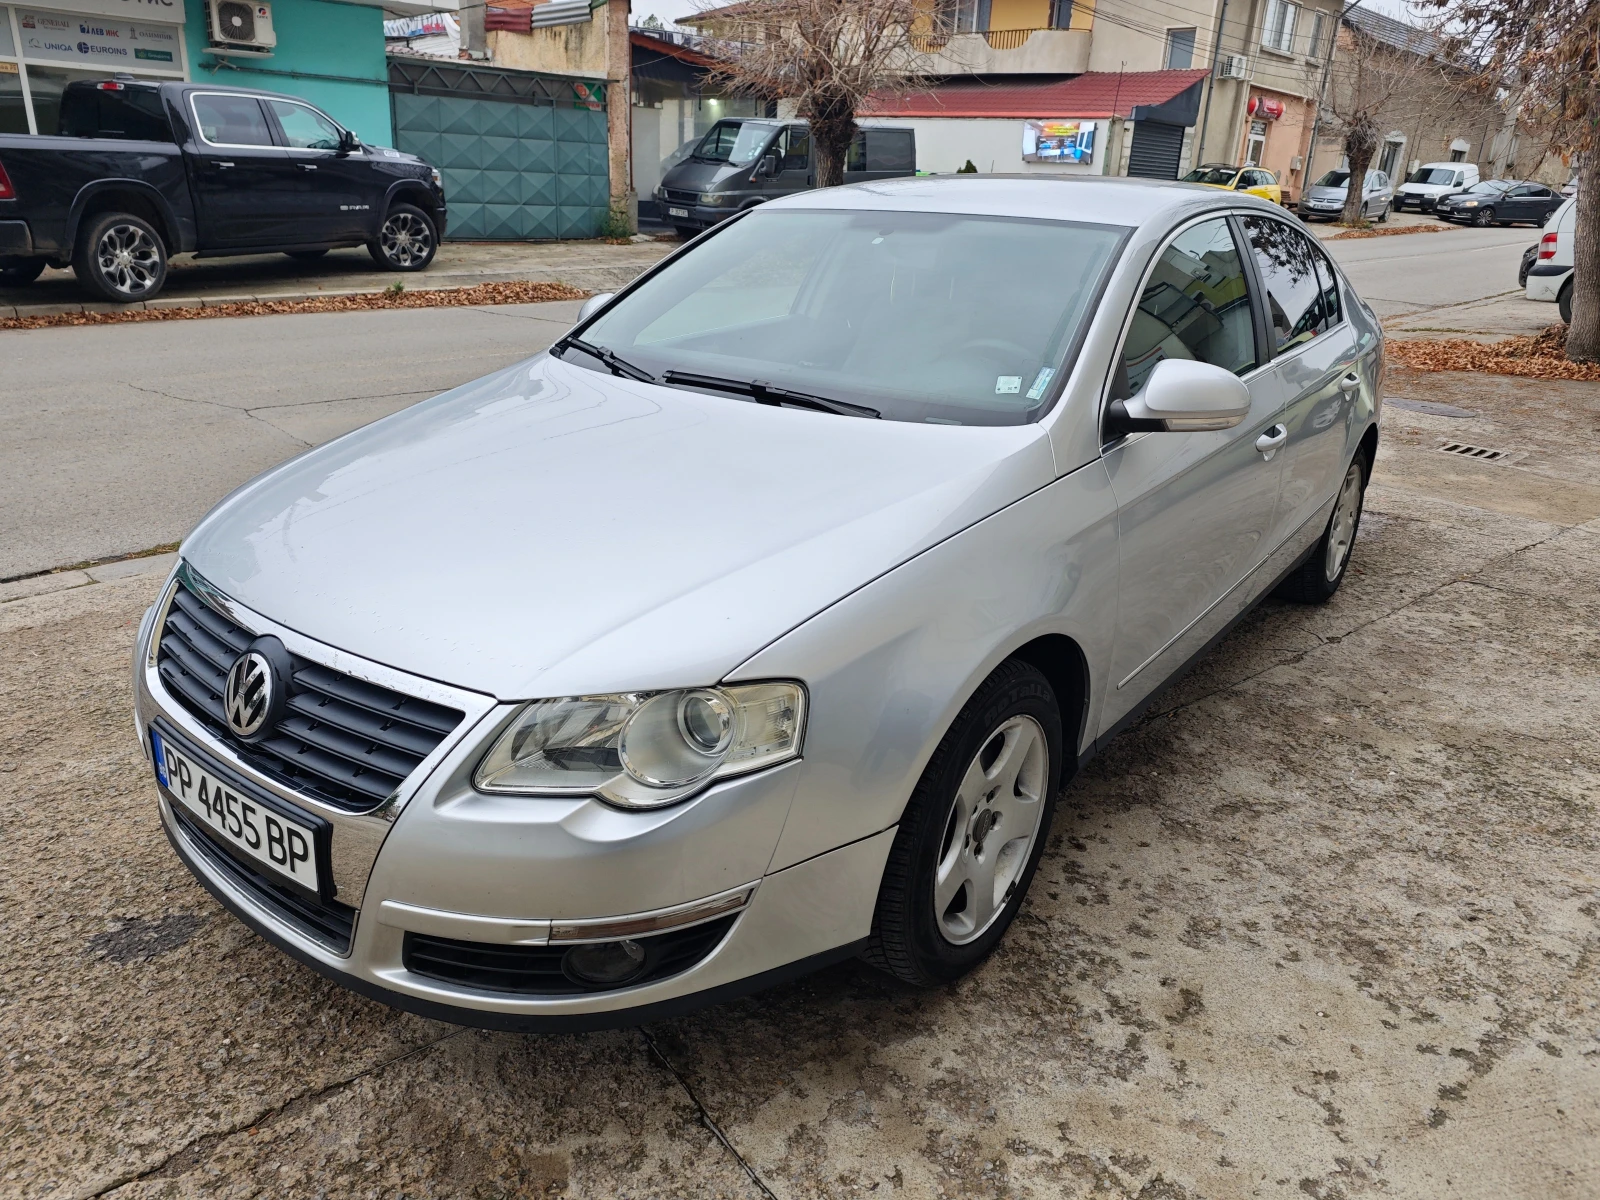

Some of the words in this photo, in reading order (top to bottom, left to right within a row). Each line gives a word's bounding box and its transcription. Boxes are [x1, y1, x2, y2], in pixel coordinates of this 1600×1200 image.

[37, 18, 69, 28] GENERALI
[91, 27, 105, 36] ЛЕВ
[105, 29, 120, 38] ИНС
[44, 42, 73, 52] UNIQA
[90, 44, 128, 55] EUROINS
[164, 745, 192, 799] PP
[198, 775, 261, 850] 4455
[265, 814, 309, 874] BP
